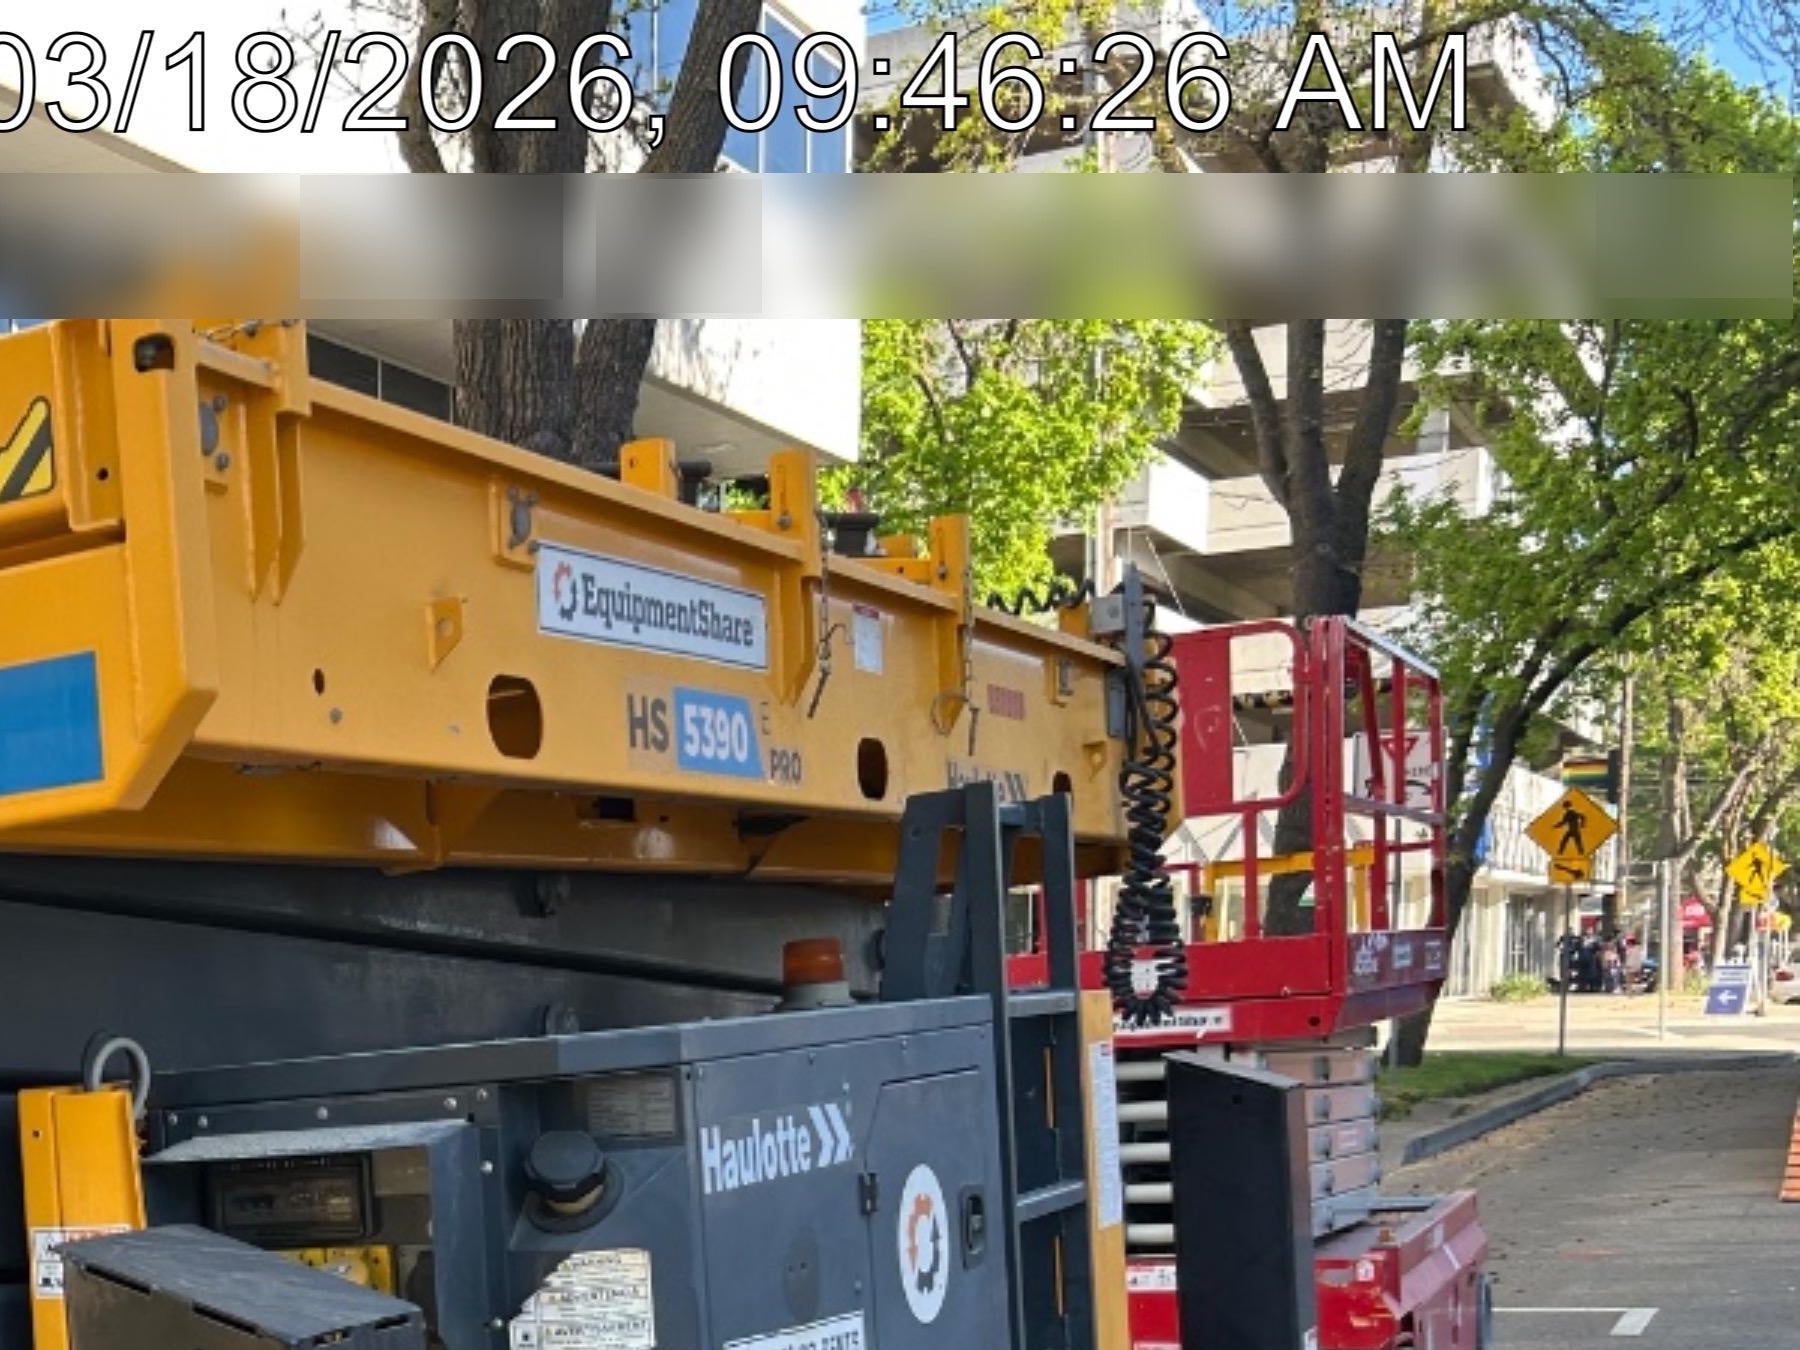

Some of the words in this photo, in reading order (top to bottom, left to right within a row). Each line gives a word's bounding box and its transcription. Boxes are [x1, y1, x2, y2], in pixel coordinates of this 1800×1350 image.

[581, 572, 755, 647] EquipmentShare
[627, 692, 670, 753] HS
[683, 703, 749, 764] 5390
[770, 748, 802, 783] PRO
[700, 1114, 811, 1195] Haulotte
